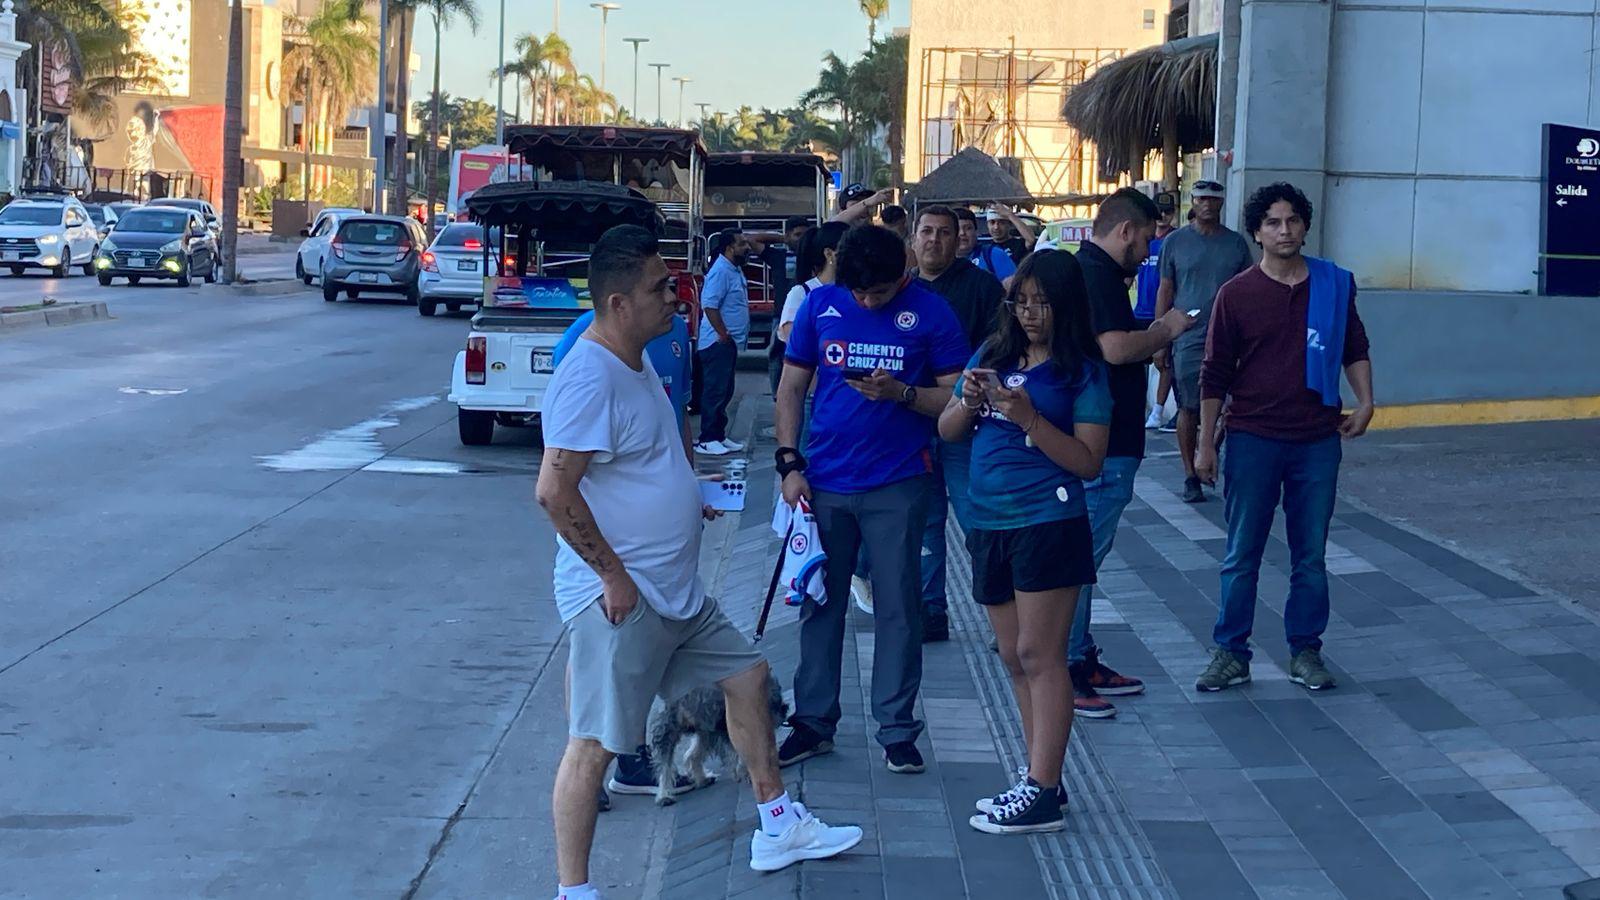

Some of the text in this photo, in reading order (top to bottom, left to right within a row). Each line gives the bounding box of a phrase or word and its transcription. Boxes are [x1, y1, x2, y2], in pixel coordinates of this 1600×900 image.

[1556, 184, 1587, 196] Salida
[848, 342, 904, 358] CEMENTO
[847, 356, 904, 371] CRUZ AZUL
